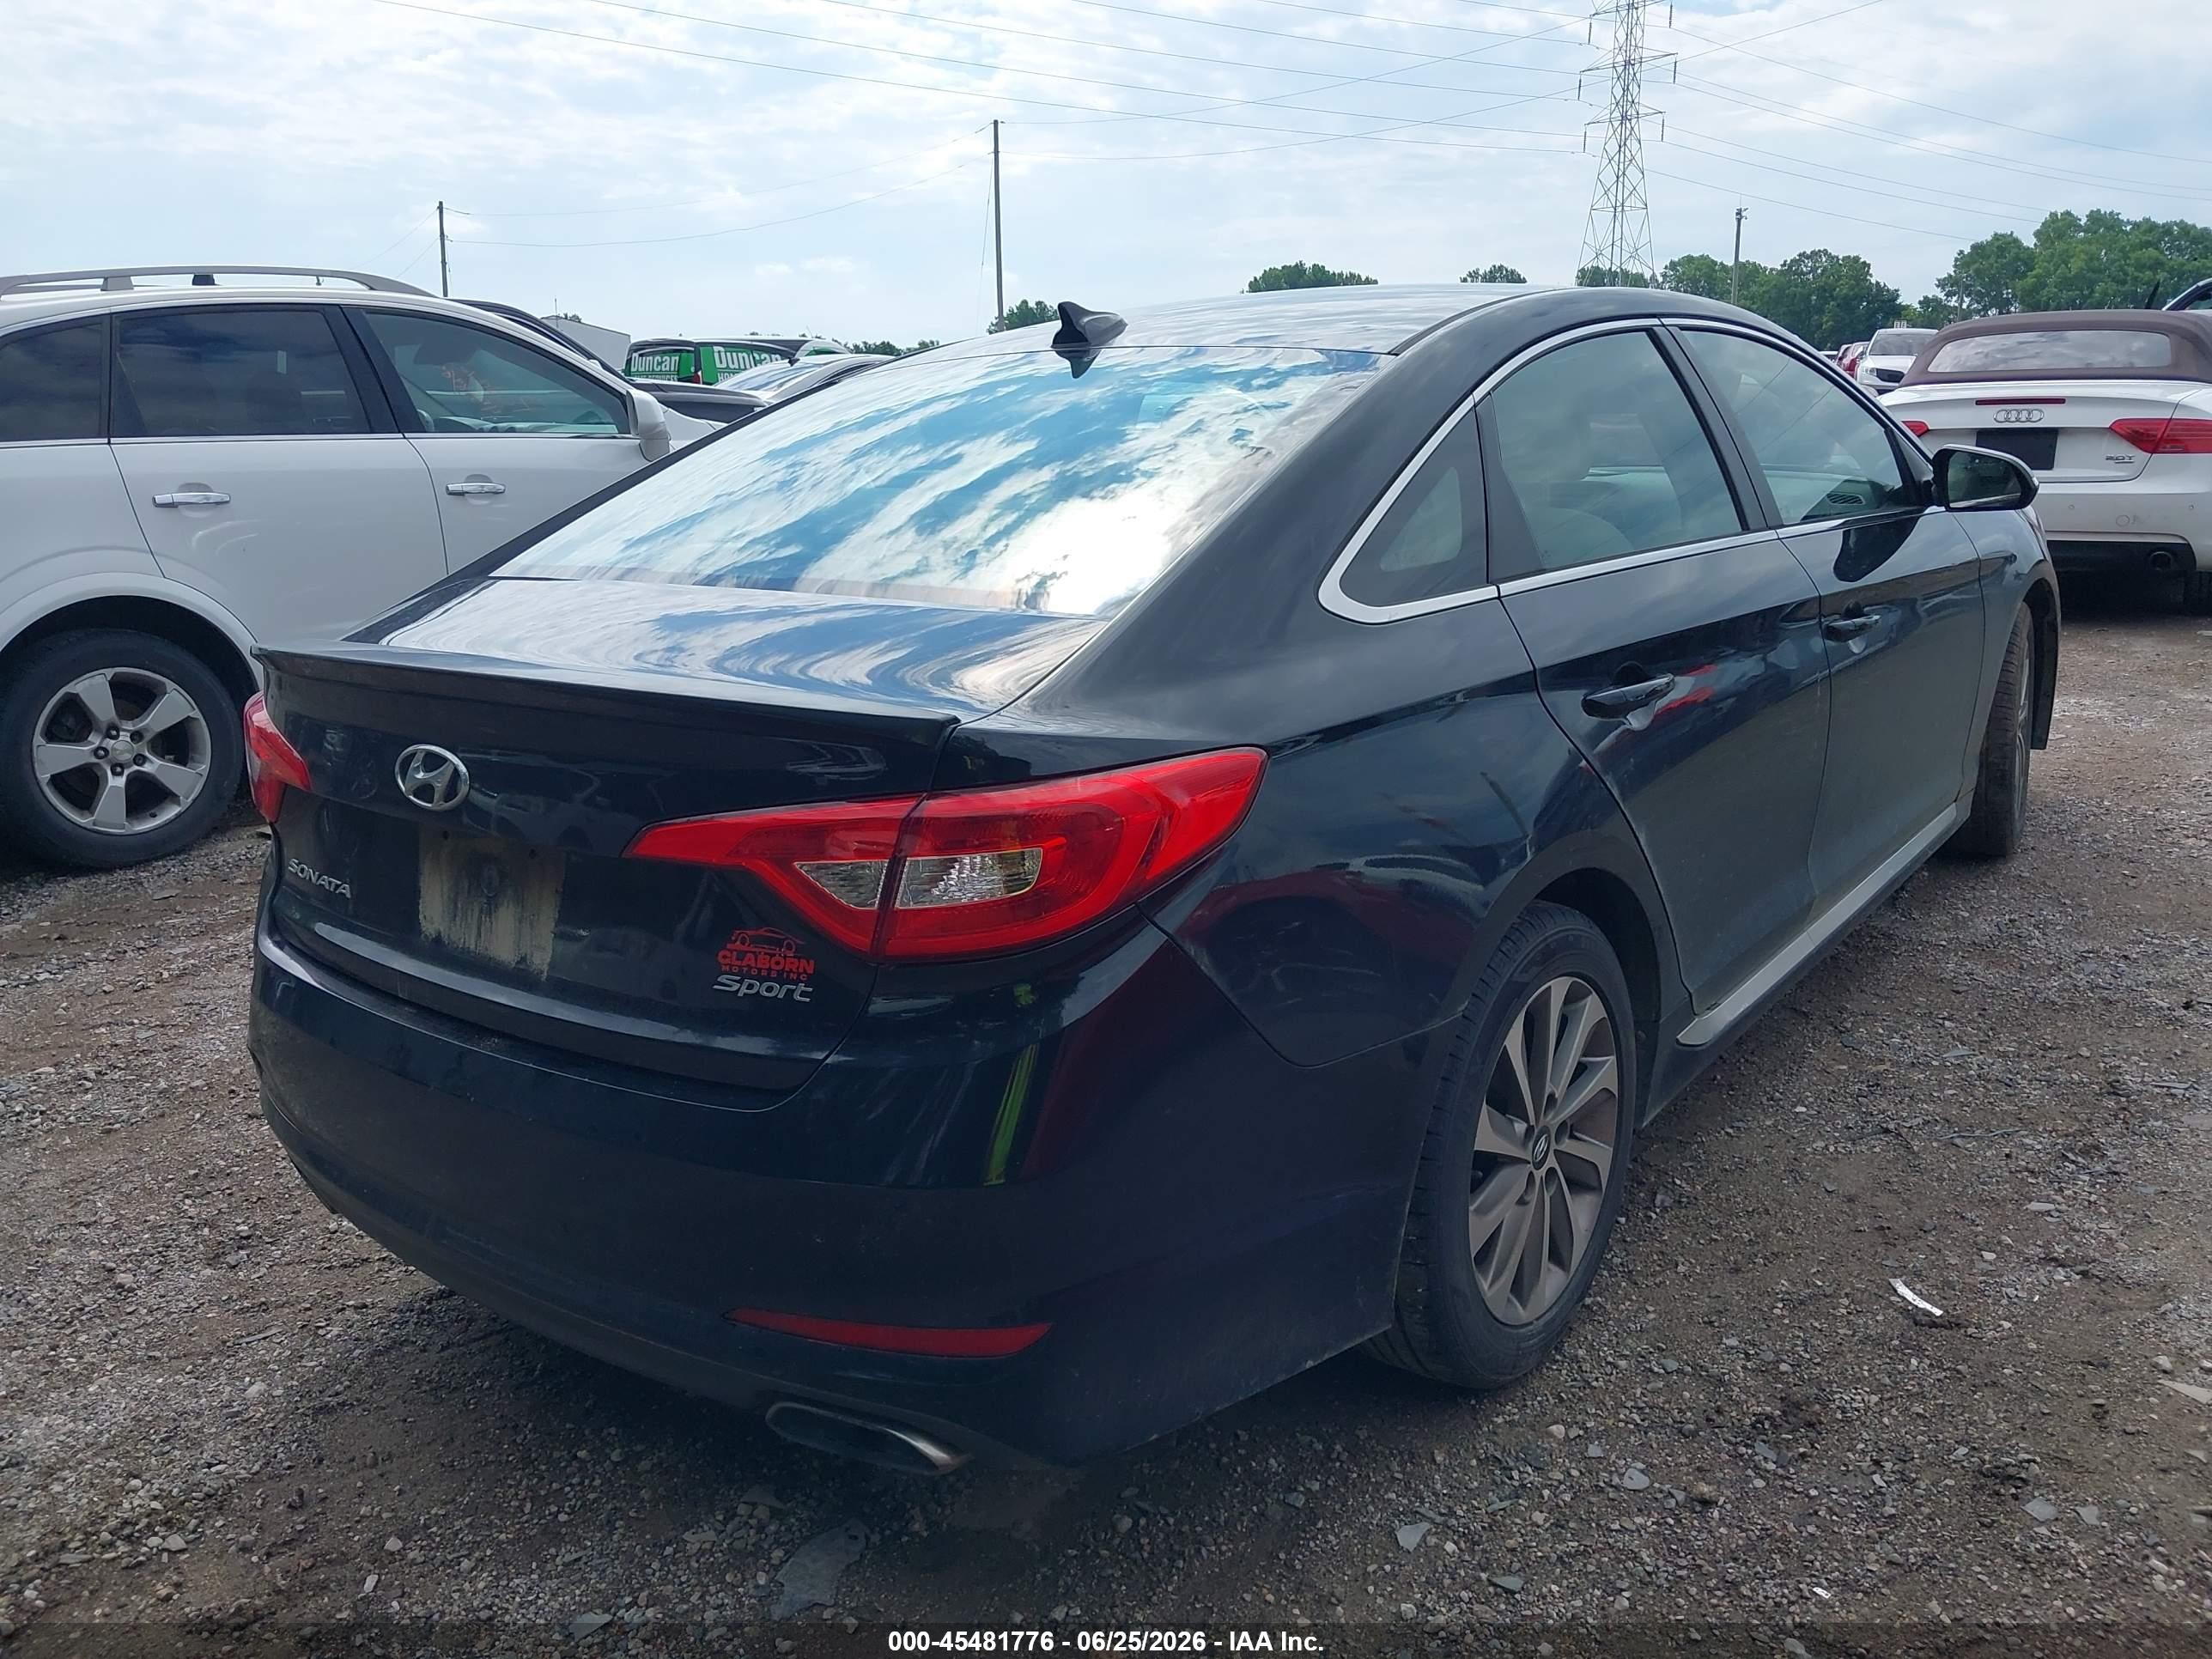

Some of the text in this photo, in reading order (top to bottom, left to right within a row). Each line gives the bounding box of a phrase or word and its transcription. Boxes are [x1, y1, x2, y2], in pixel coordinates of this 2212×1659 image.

[631, 353, 679, 372] Duncan
[288, 858, 351, 899] SONATA
[718, 950, 815, 974] CLABORN
[713, 975, 813, 1002] Sport
